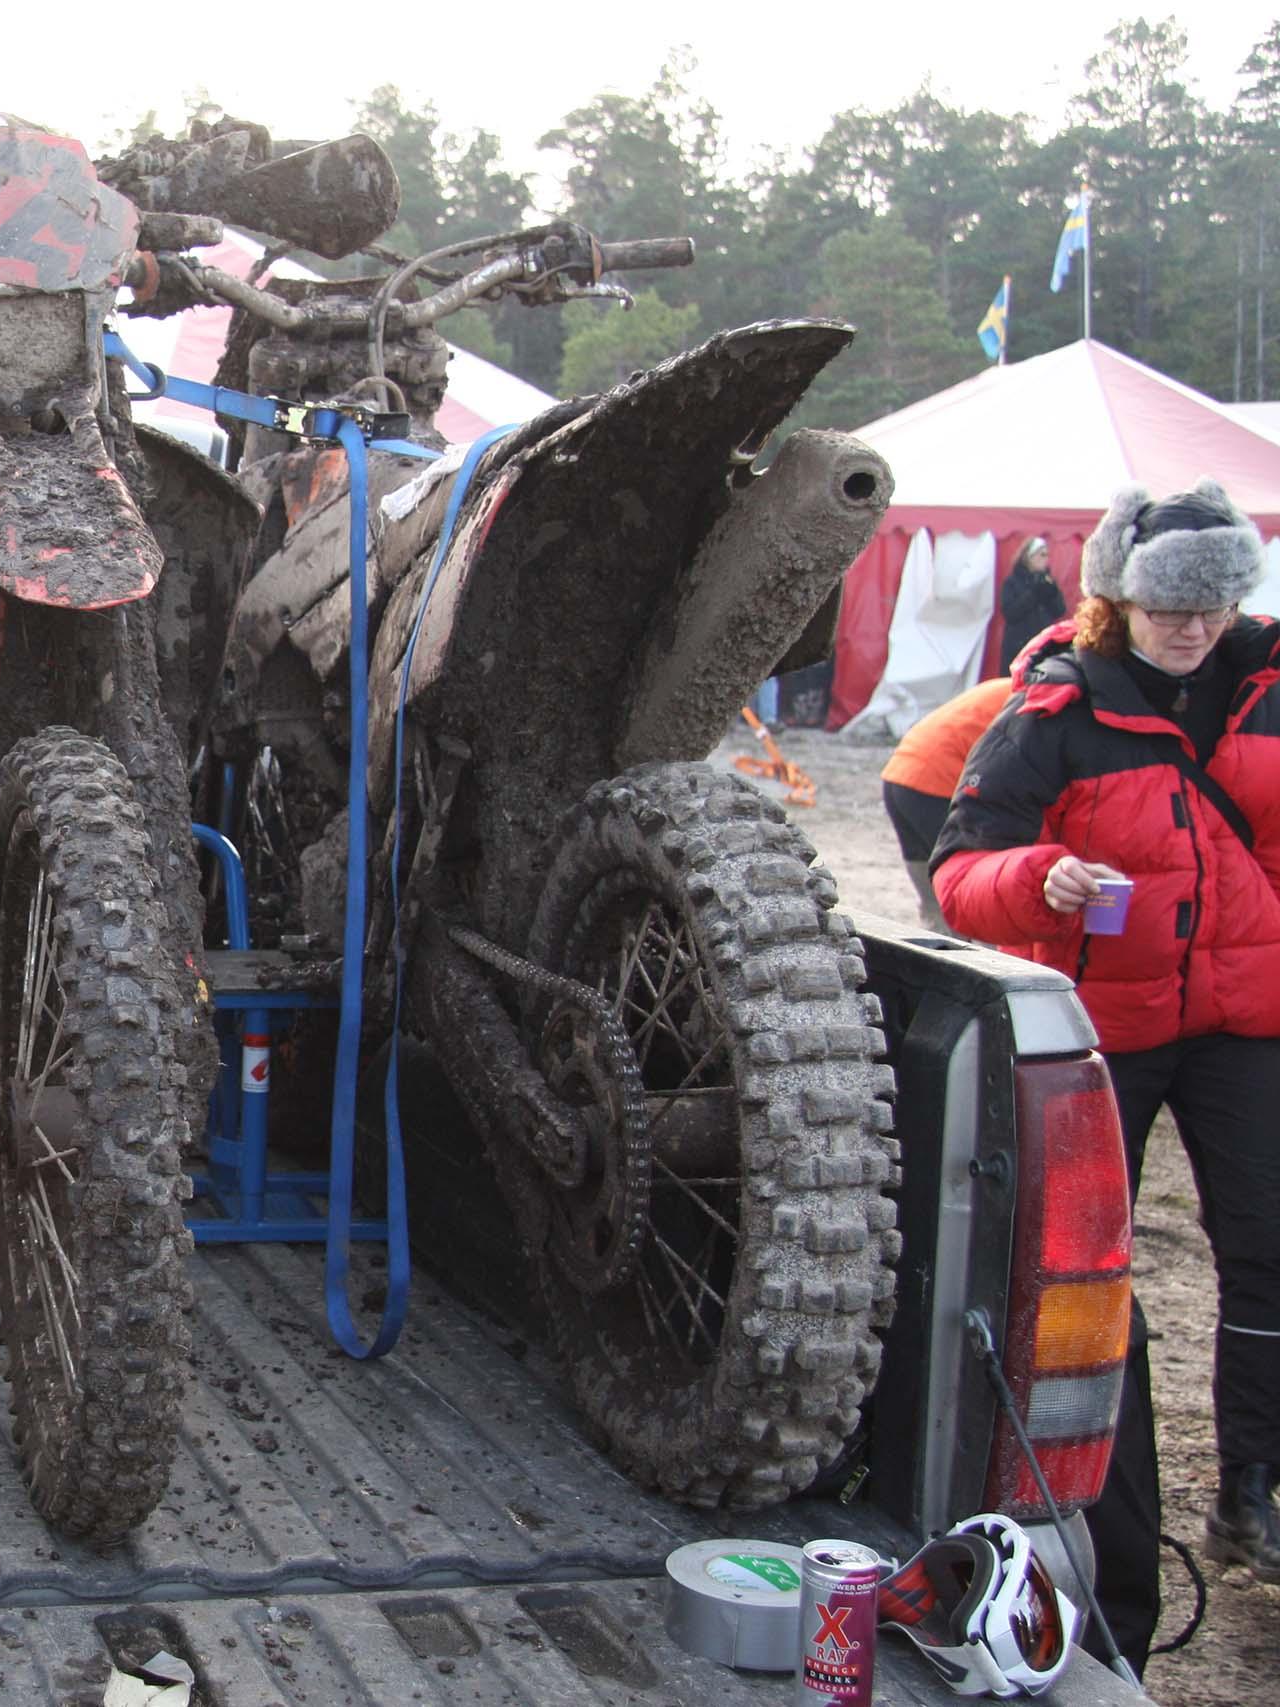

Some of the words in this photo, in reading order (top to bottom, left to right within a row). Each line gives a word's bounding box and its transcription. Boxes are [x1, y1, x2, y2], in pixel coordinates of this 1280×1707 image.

[810, 1601, 852, 1649] X
[816, 1646, 849, 1665] RAY
[806, 1659, 857, 1673] ENERGY
[809, 1670, 852, 1684] DRINK
